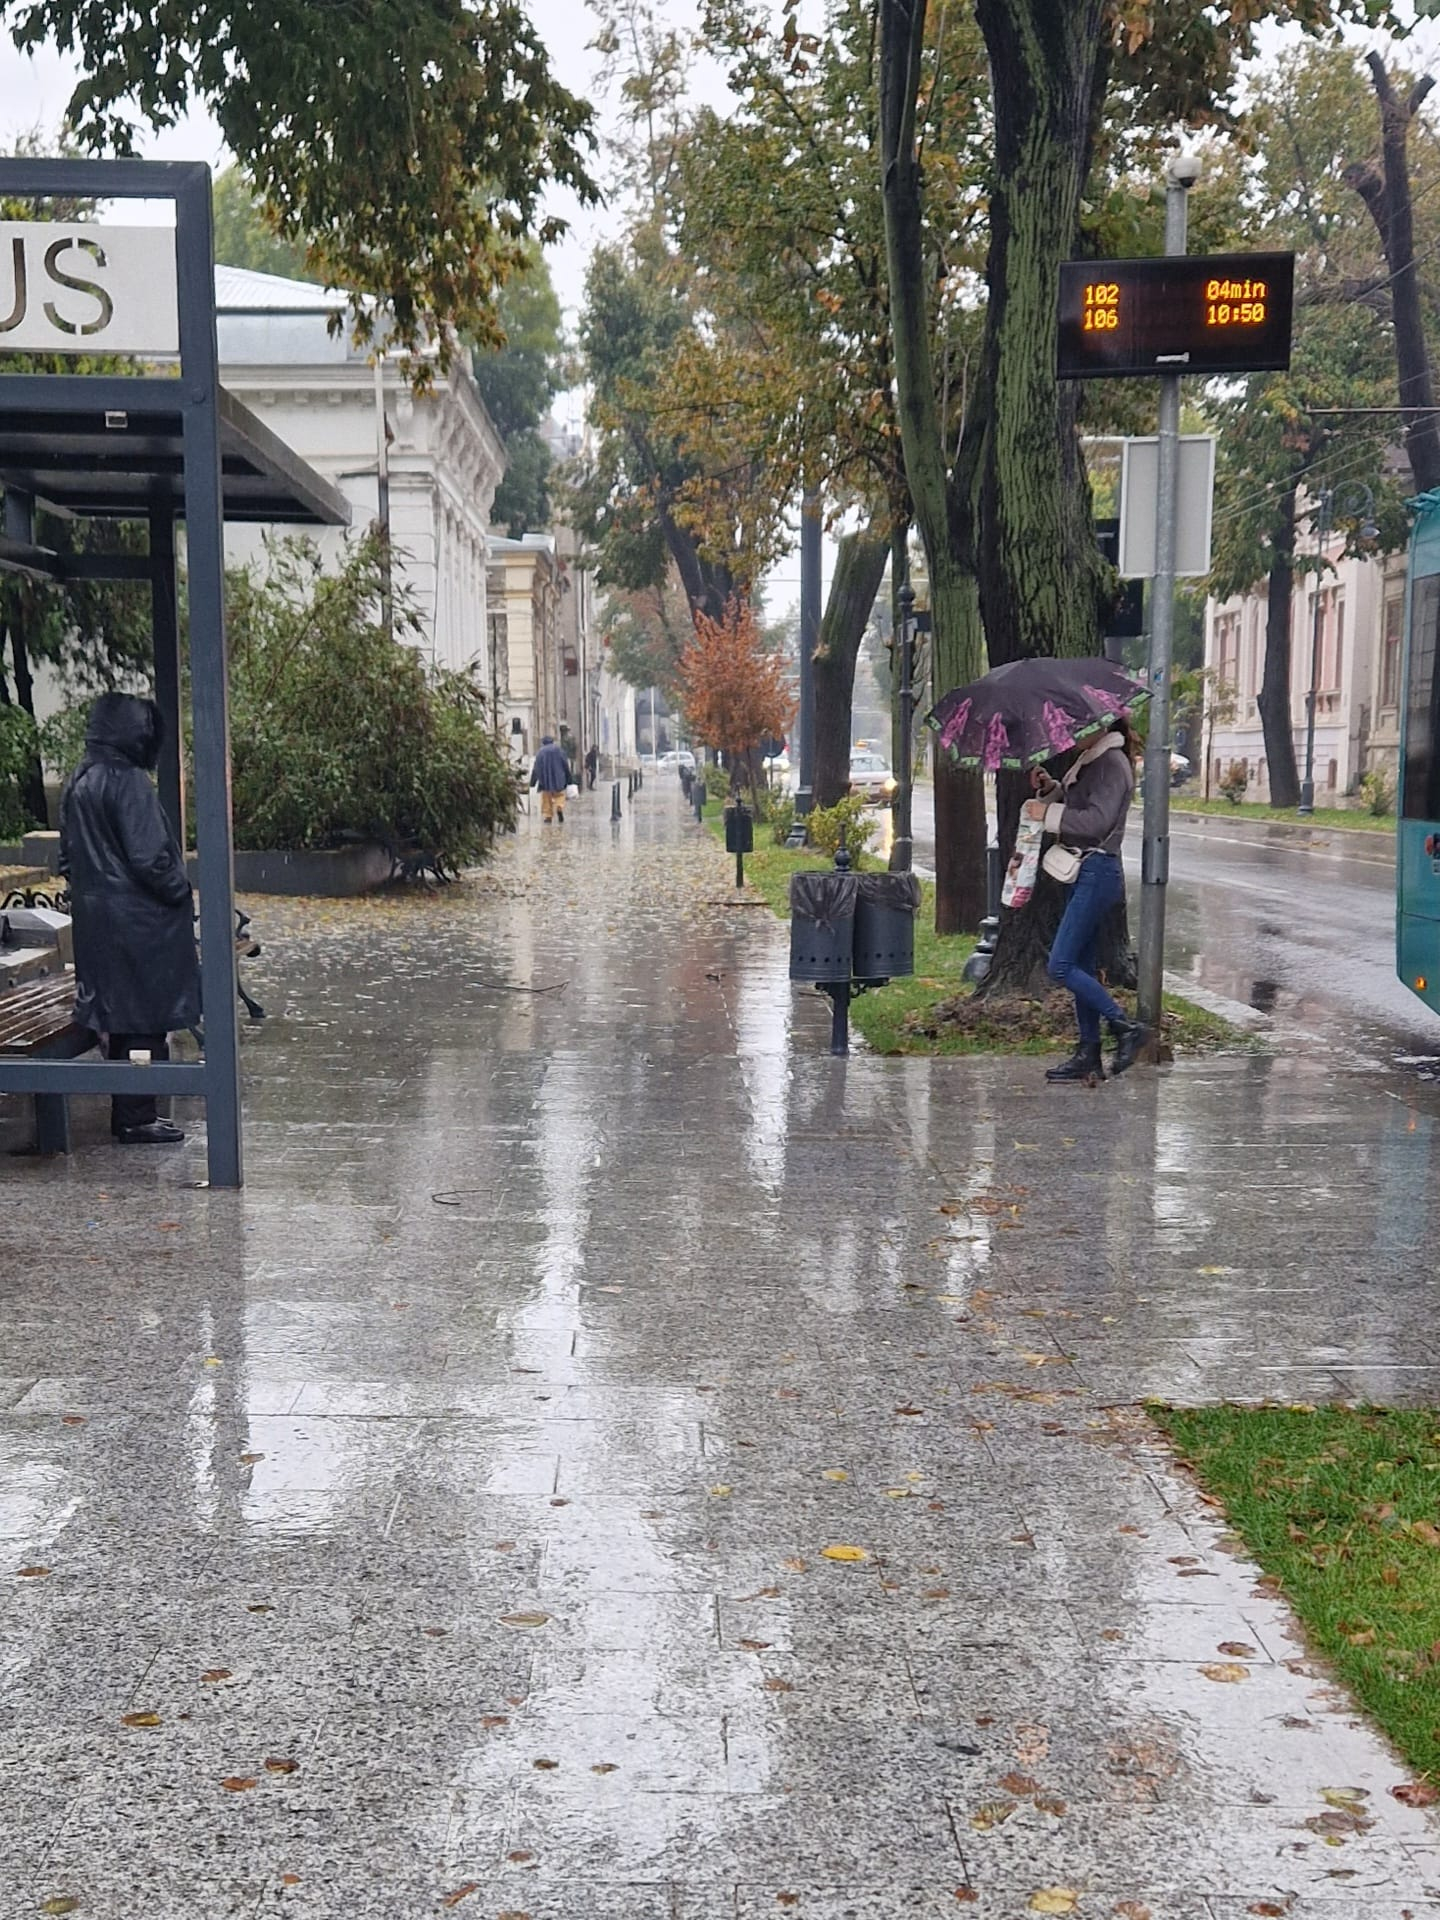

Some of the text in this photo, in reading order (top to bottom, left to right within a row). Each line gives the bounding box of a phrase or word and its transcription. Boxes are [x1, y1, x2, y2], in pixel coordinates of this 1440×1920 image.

[1085, 279, 1266, 305] 102 04min
[1084, 302, 1265, 330] 106 10:50
